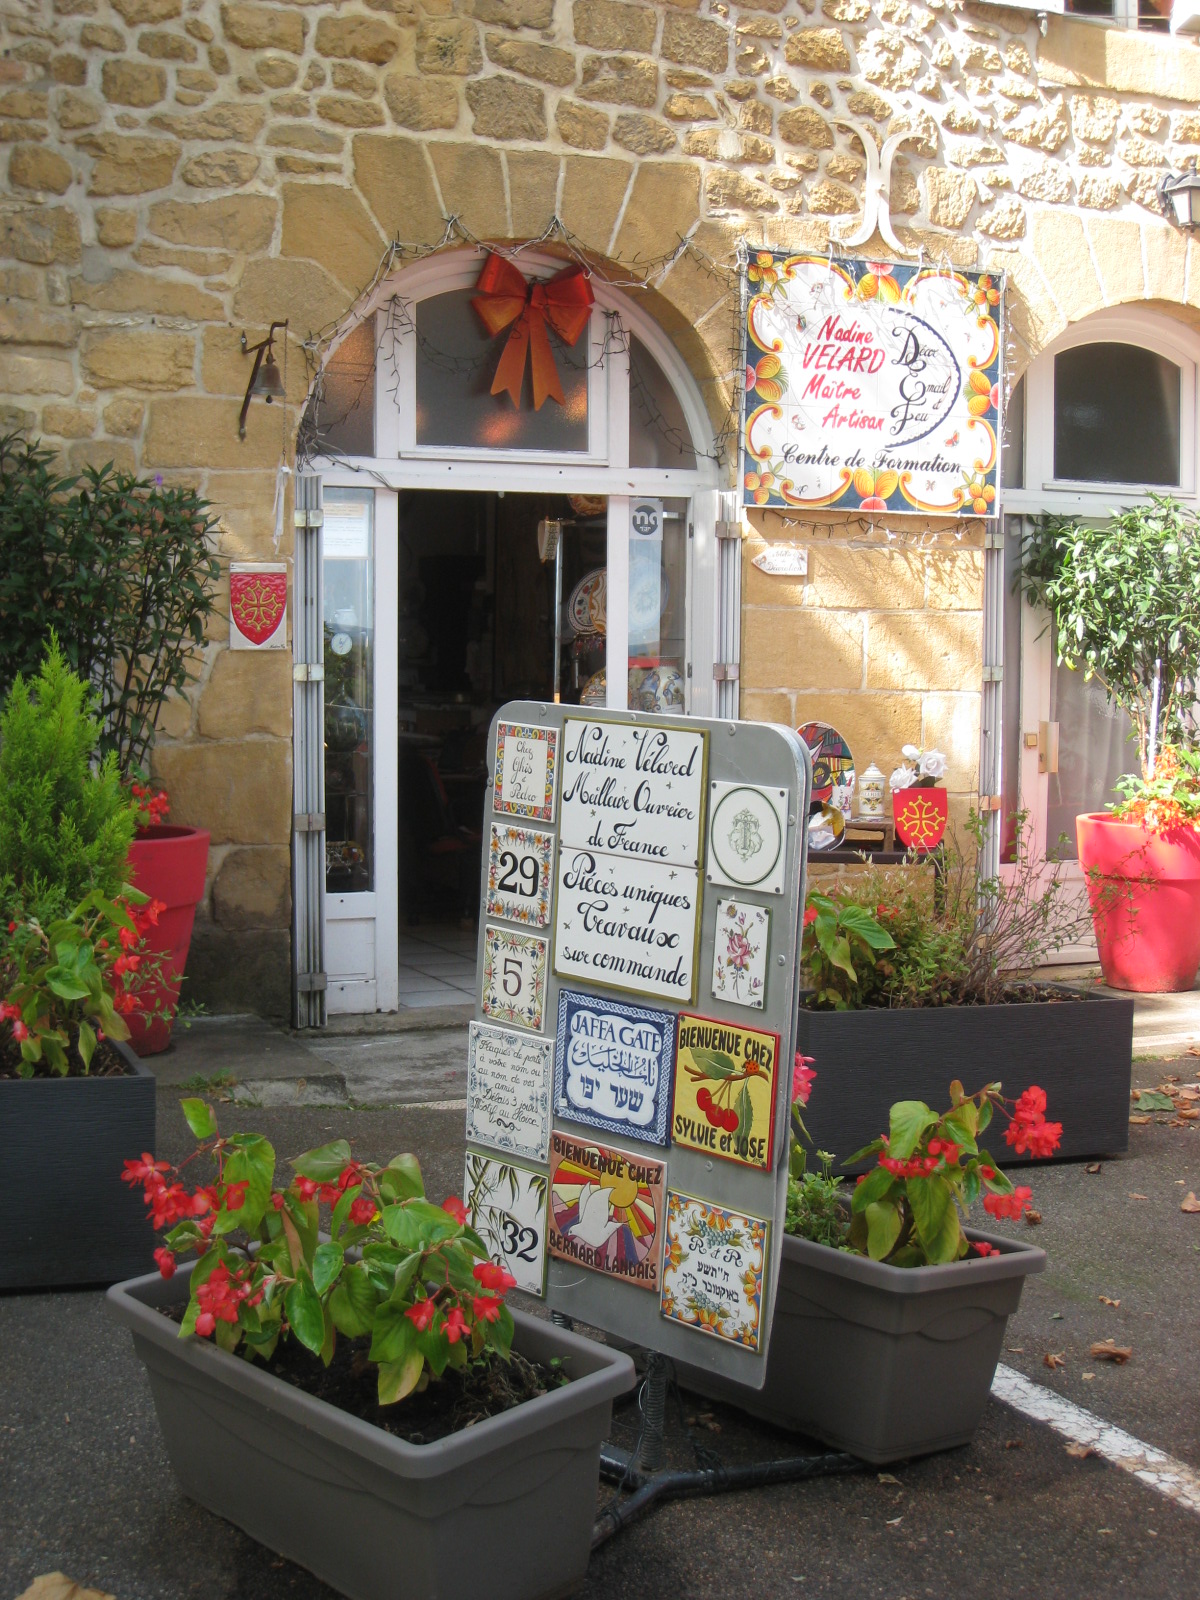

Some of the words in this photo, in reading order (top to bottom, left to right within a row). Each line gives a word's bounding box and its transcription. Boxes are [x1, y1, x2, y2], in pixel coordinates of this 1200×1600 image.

[817, 315, 874, 345] Nadine
[802, 343, 886, 374] VELARD
[801, 373, 862, 400] Maître
[821, 403, 885, 431] Artisan
[781, 442, 841, 467] Centre
[844, 448, 866, 468] de
[872, 448, 962, 474] Formation
[516, 740, 534, 761] Chez
[565, 723, 627, 769] Nadine
[632, 729, 699, 777] Vélard
[510, 782, 537, 802] Pedro
[586, 819, 604, 848] de
[607, 818, 670, 858] France
[498, 851, 539, 898] 29
[621, 884, 691, 925] uniques
[576, 899, 681, 950] Travaux
[503, 958, 523, 997] 5
[592, 955, 689, 987] commande
[571, 1014, 617, 1043] JAFFA
[618, 1026, 661, 1053] GATE
[478, 1039, 511, 1058] Plaques
[513, 1047, 523, 1060] de
[522, 1054, 542, 1066] porte
[488, 1058, 507, 1069] votre
[510, 1064, 530, 1075] nom
[530, 1069, 542, 1077] ou
[743, 1037, 774, 1074] CHEZ
[477, 1066, 489, 1076] au
[490, 1071, 508, 1082] nom
[510, 1074, 521, 1085] de
[522, 1079, 535, 1088] vos
[494, 1082, 515, 1094] amis
[510, 1097, 518, 1107] 3
[518, 1101, 540, 1114] jours
[609, 1082, 645, 1113] שער
[499, 1109, 511, 1120] au
[719, 1132, 732, 1154] et
[733, 1134, 766, 1160] JOSE
[627, 1163, 663, 1186] CHEZ
[500, 1219, 540, 1264] 32
[549, 1228, 603, 1268] BERNARD
[688, 1236, 707, 1255] R
[722, 1248, 744, 1268] R
